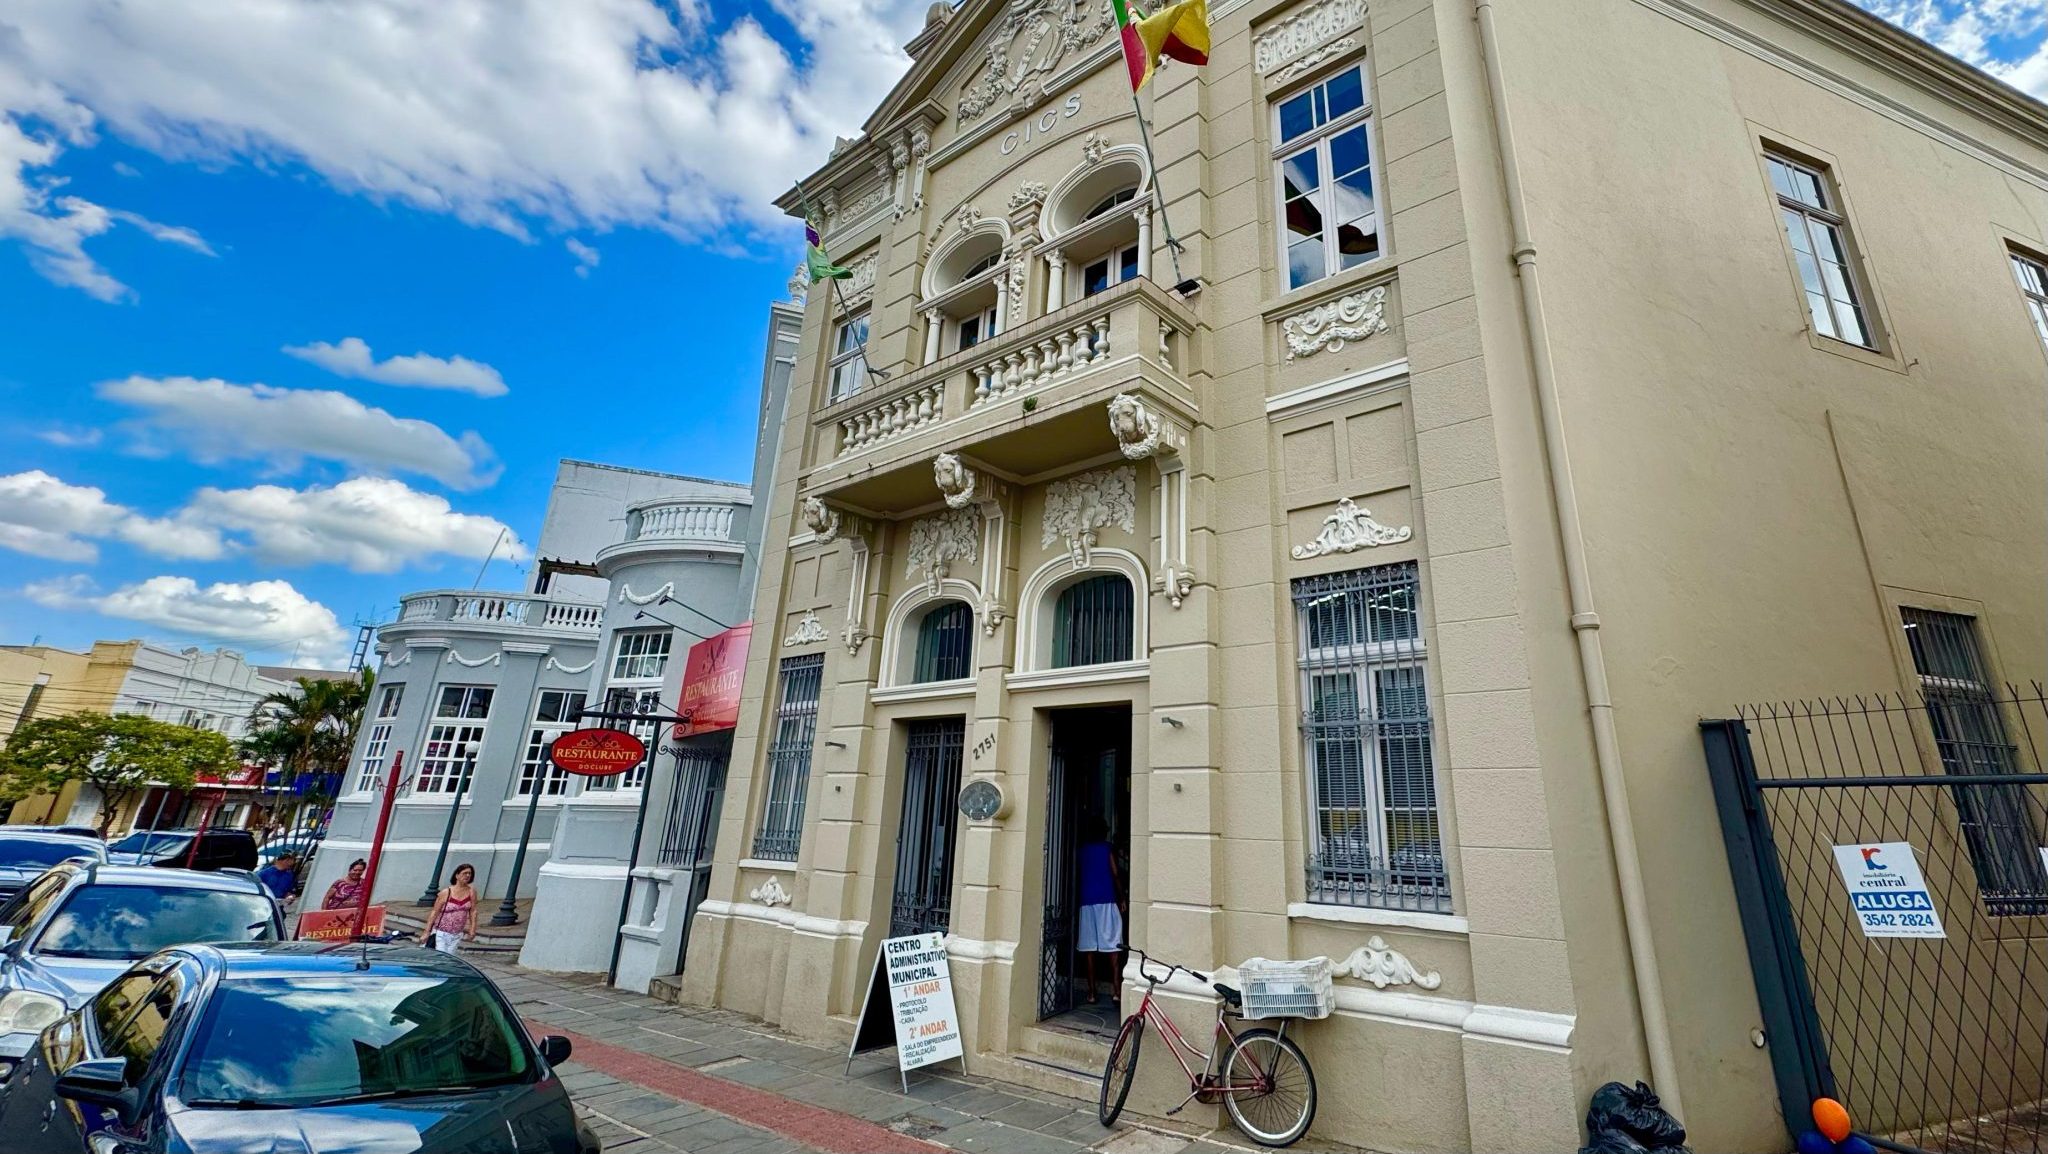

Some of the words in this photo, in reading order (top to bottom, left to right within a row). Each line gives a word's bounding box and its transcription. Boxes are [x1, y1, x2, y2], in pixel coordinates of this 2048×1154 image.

[1001, 93, 1081, 155] CICS
[684, 670, 739, 701] RESTAURANTE
[556, 748, 638, 761] RESTAURANTE
[973, 733, 996, 760] 2751
[1860, 876, 1907, 887] central
[1857, 894, 1930, 909] ALUGA
[1863, 914, 1897, 926] 3542
[1899, 914, 1934, 926] 2824
[887, 939, 921, 953] CENTRO
[890, 949, 946, 969] ADMINISTRATIVO
[892, 966, 937, 984] MUNICIPAL
[913, 981, 941, 997] ANDAR
[919, 1020, 948, 1037] ANDAR
